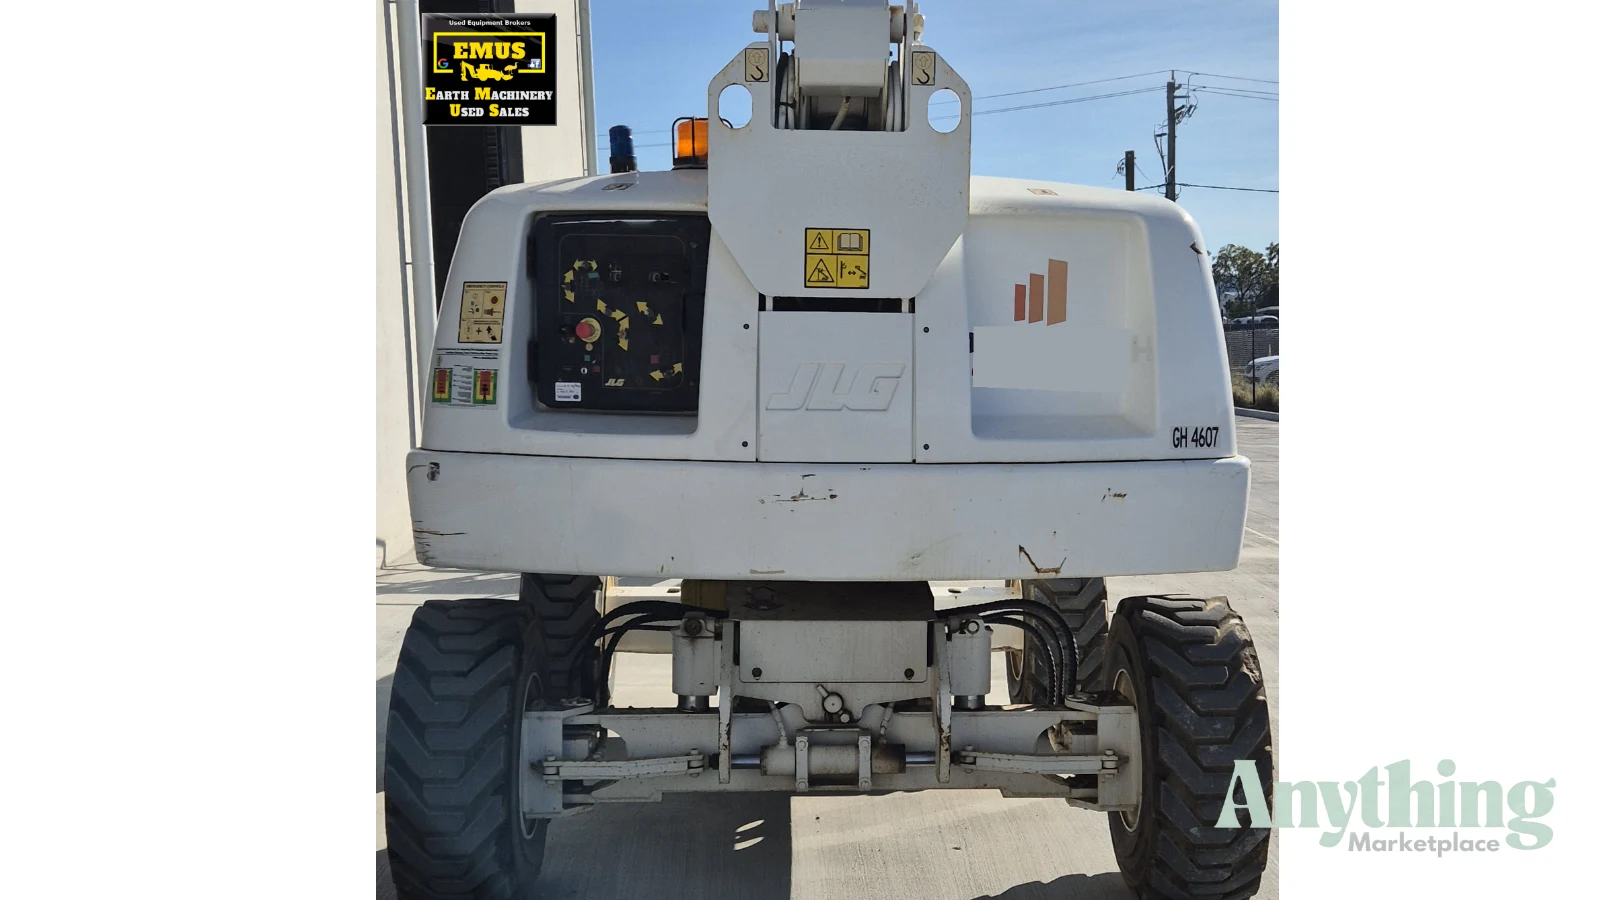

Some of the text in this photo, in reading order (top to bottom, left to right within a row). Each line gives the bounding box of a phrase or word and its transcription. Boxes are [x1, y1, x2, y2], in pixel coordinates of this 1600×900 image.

[604, 378, 626, 387] JLG
[765, 362, 907, 411] JLG
[1172, 426, 1219, 448] GH 4607
